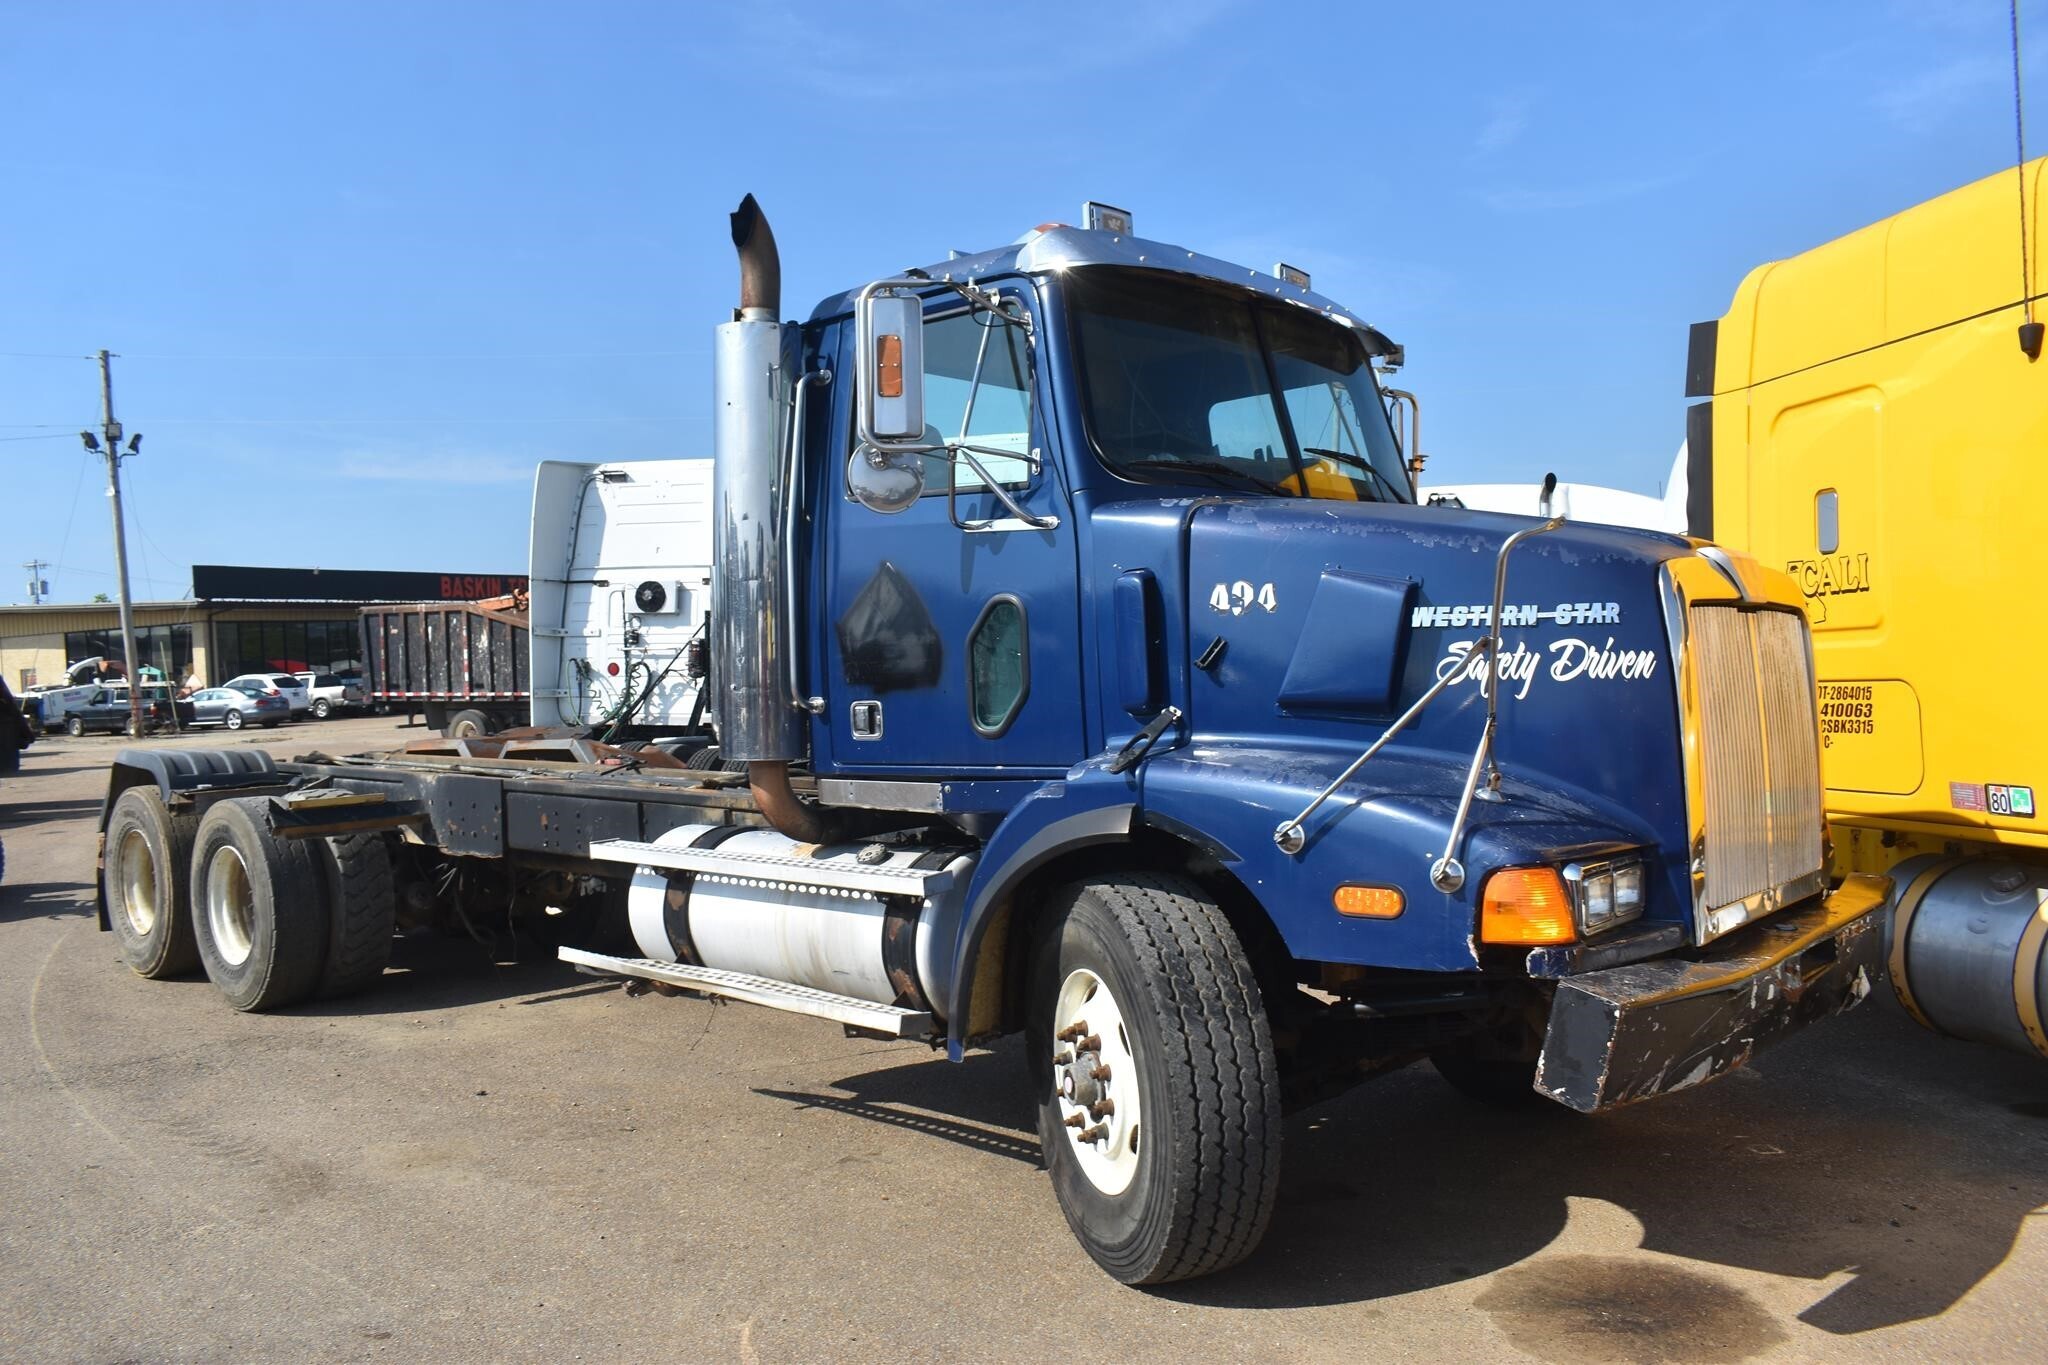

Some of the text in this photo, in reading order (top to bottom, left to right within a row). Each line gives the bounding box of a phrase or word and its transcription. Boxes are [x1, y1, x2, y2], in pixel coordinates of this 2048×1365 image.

[440, 575, 502, 598] BASKIN
[1799, 553, 1870, 598] CALI
[1554, 602, 1621, 626] STAR
[1548, 636, 1657, 683] Driven
[1991, 792, 2008, 813] 80
